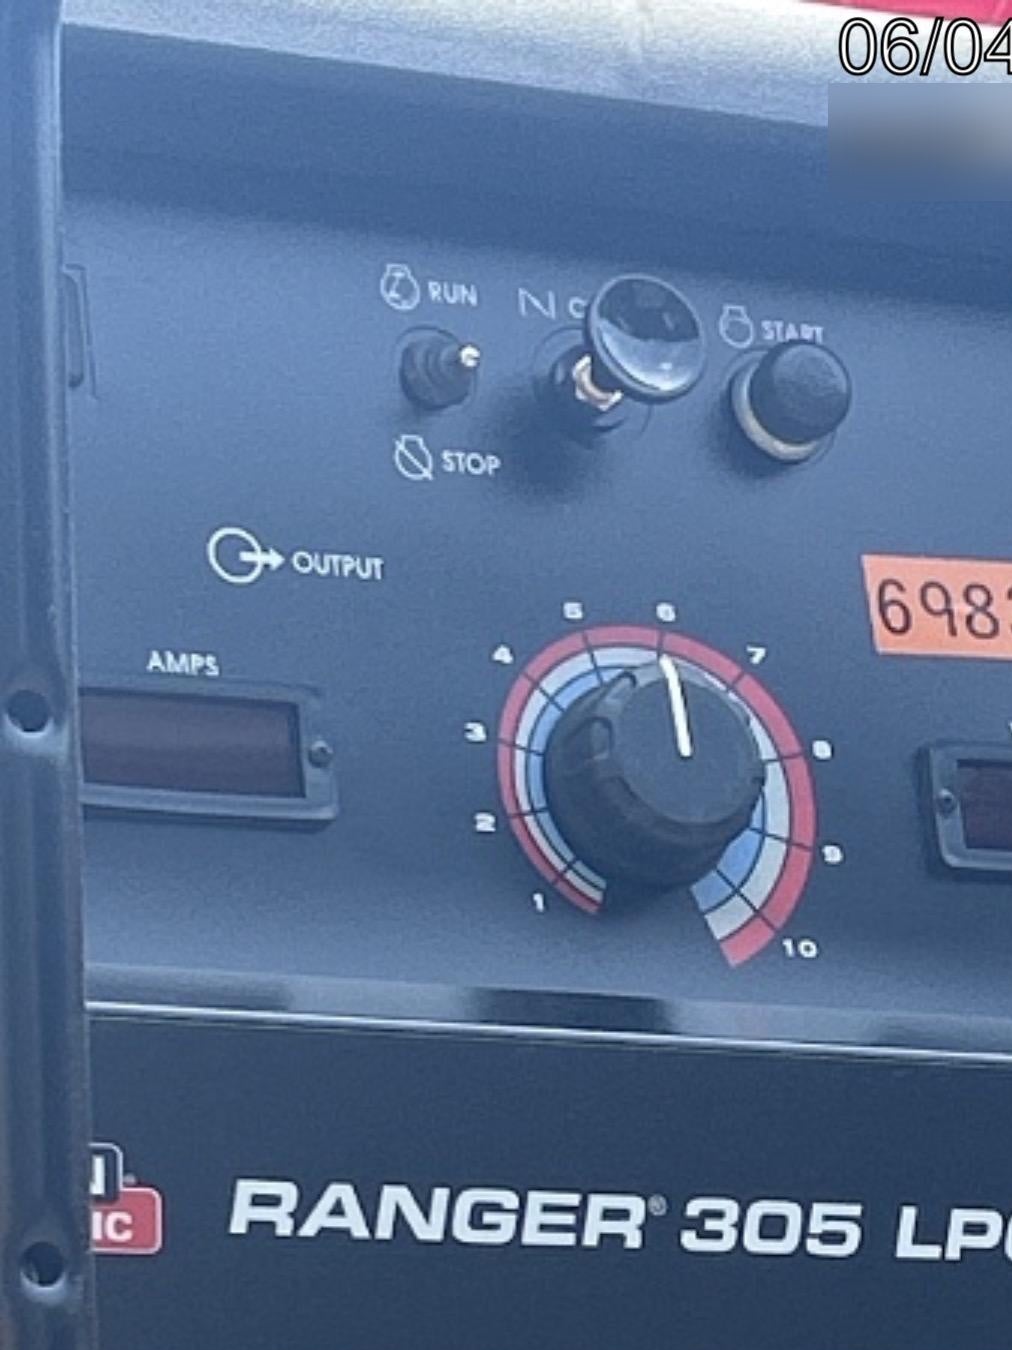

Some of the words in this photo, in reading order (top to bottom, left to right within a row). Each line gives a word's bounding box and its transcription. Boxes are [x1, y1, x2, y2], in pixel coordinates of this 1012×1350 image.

[428, 281, 478, 305] RUN
[440, 451, 500, 476] STOP
[290, 550, 385, 581] OUTPUT
[563, 601, 583, 619] 5
[656, 602, 676, 621] 6
[146, 649, 220, 677] AMPS
[492, 644, 513, 663] 4
[746, 645, 766, 664] 7
[464, 721, 487, 742] 3
[473, 811, 496, 833] 2
[822, 844, 843, 864] 9
[532, 892, 545, 912] 1
[782, 938, 818, 959] 10
[680, 1196, 863, 1258] 305
